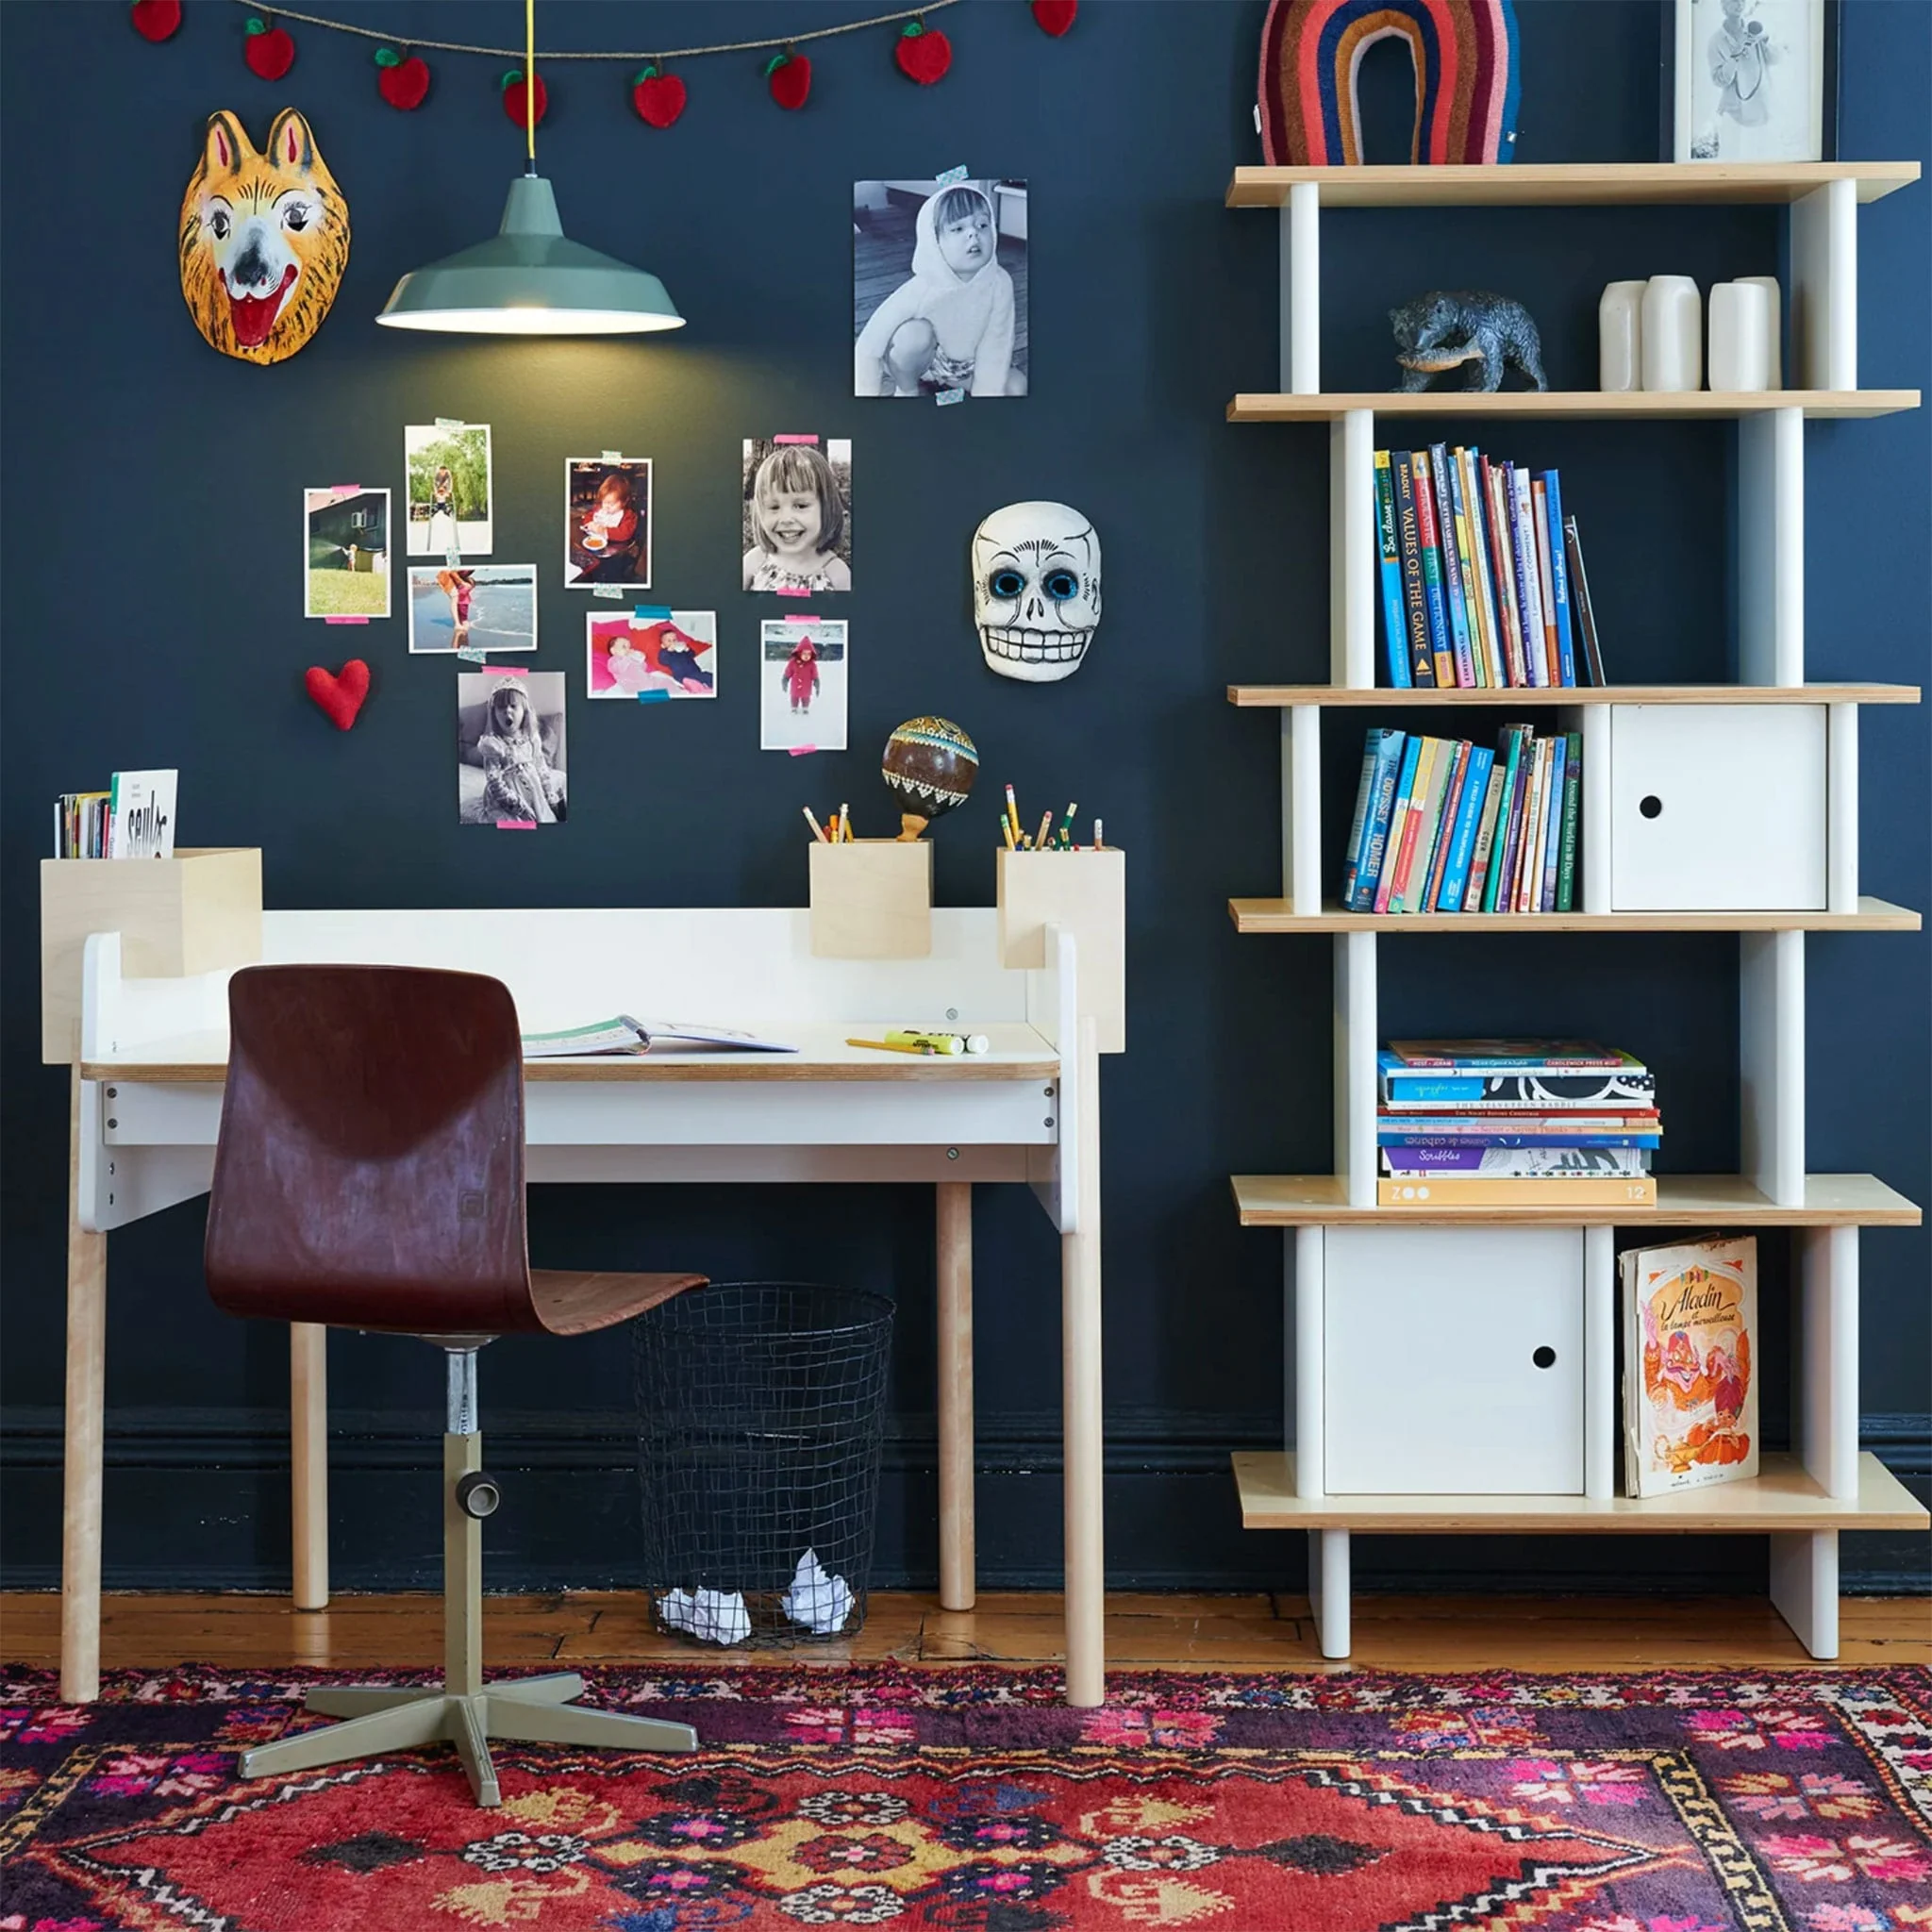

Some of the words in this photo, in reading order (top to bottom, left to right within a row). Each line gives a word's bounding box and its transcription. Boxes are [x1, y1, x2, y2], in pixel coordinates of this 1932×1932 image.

[1400, 464, 1410, 499] BRADLEY
[1403, 508, 1417, 555] VALUES
[1442, 501, 1453, 548] MERVEILLES
[1407, 558, 1419, 576] OF
[1409, 580, 1422, 608] THE
[1413, 611, 1425, 650] GAME
[1431, 588, 1446, 649] DICTIONARY
[1376, 777, 1392, 824] ODYSSEY
[1568, 778, 1576, 807] Around
[1566, 822, 1575, 843] World
[1366, 833, 1385, 877] HOMER
[1563, 861, 1573, 879] Days
[1404, 1136, 1445, 1146] cabanes
[1391, 1186, 1430, 1200] ZOO
[1626, 1187, 1644, 1199] 12
[1660, 1283, 1736, 1321] Aladin
